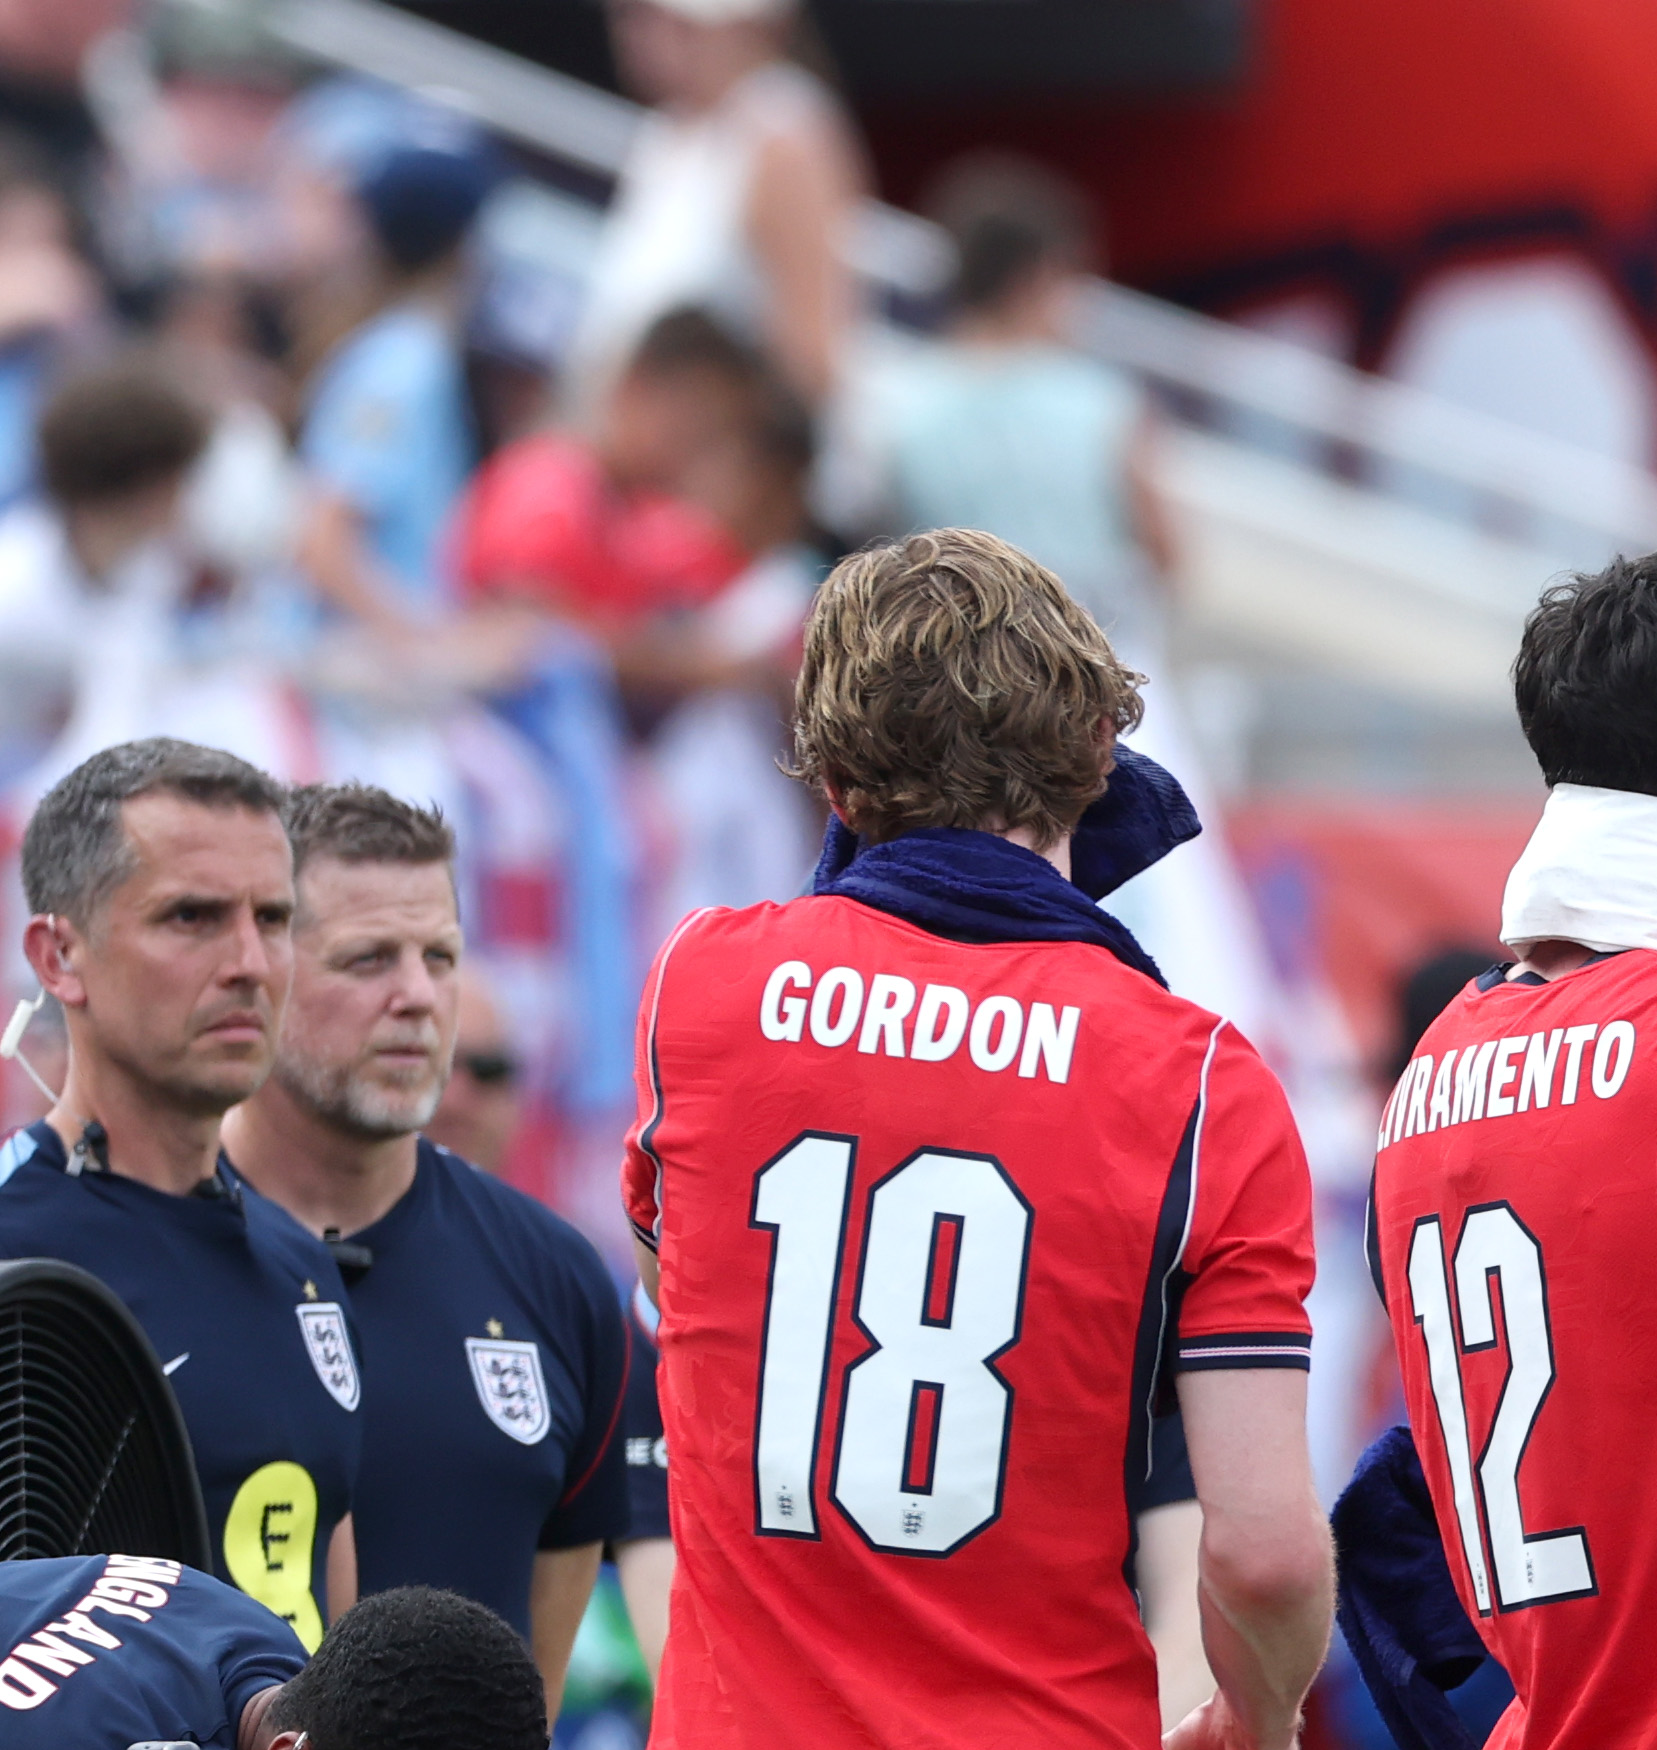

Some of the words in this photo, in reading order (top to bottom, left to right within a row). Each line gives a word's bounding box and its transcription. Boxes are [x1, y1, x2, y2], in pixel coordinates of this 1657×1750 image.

[760, 961, 1081, 1084] GORDON
[748, 1129, 1035, 1559] 18
[1405, 1200, 1600, 1618] 12
